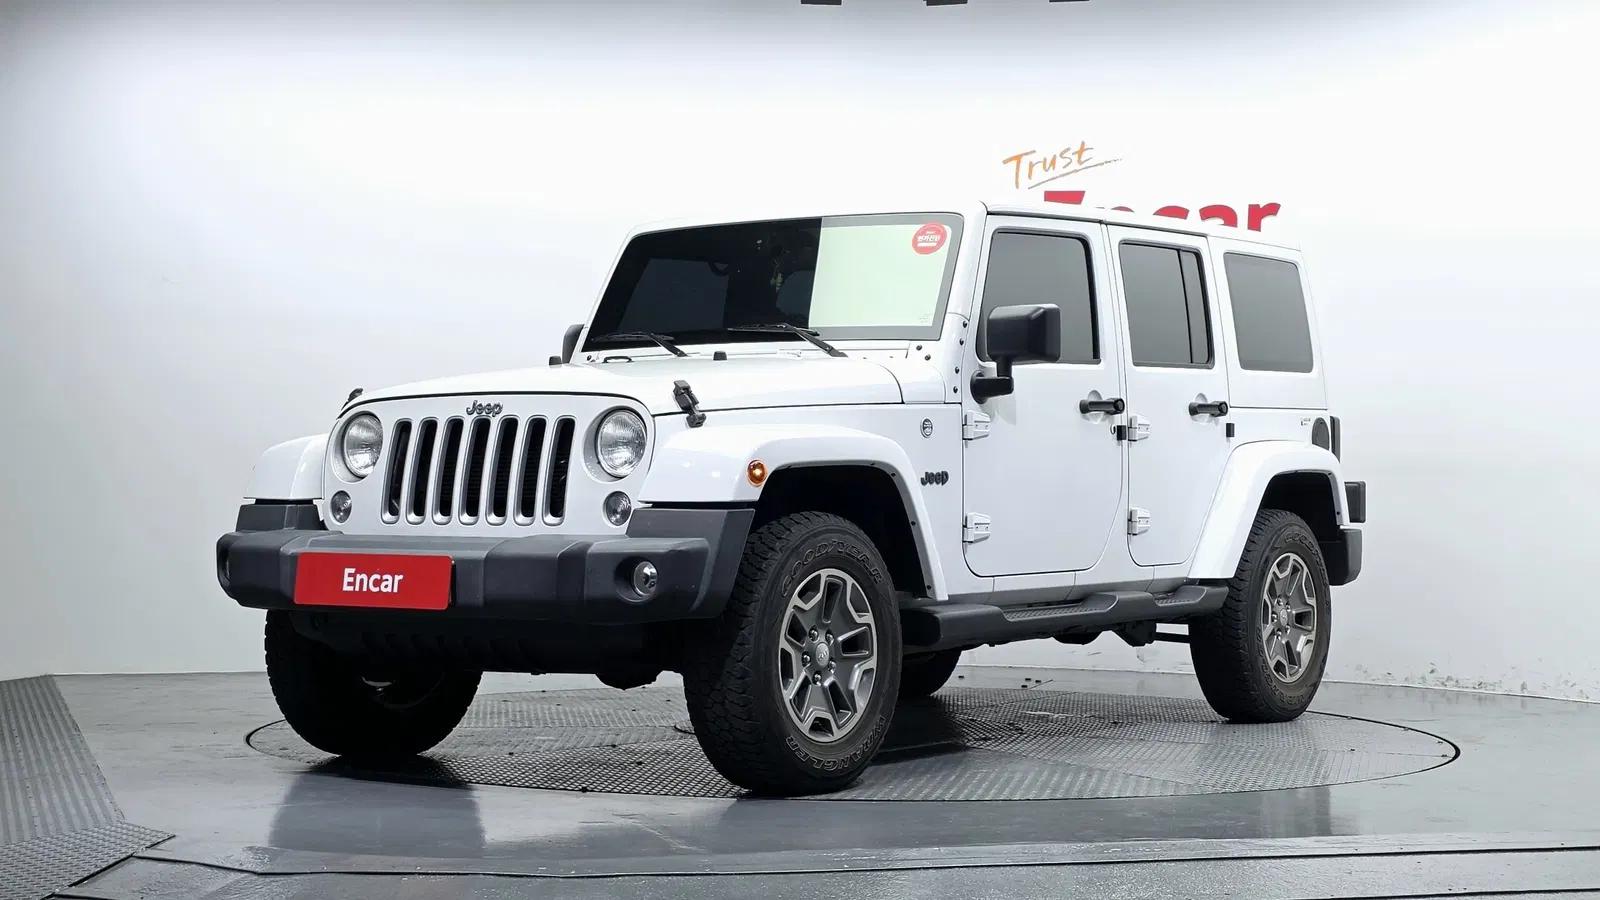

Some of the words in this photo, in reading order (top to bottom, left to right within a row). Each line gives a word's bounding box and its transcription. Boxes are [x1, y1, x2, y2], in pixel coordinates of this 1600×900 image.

[1002, 141, 1094, 190] Trust
[466, 399, 504, 417] Jeep
[342, 567, 404, 593] Encar
[781, 538, 885, 597] GOODYEAR
[785, 715, 886, 772] WRANGLER
